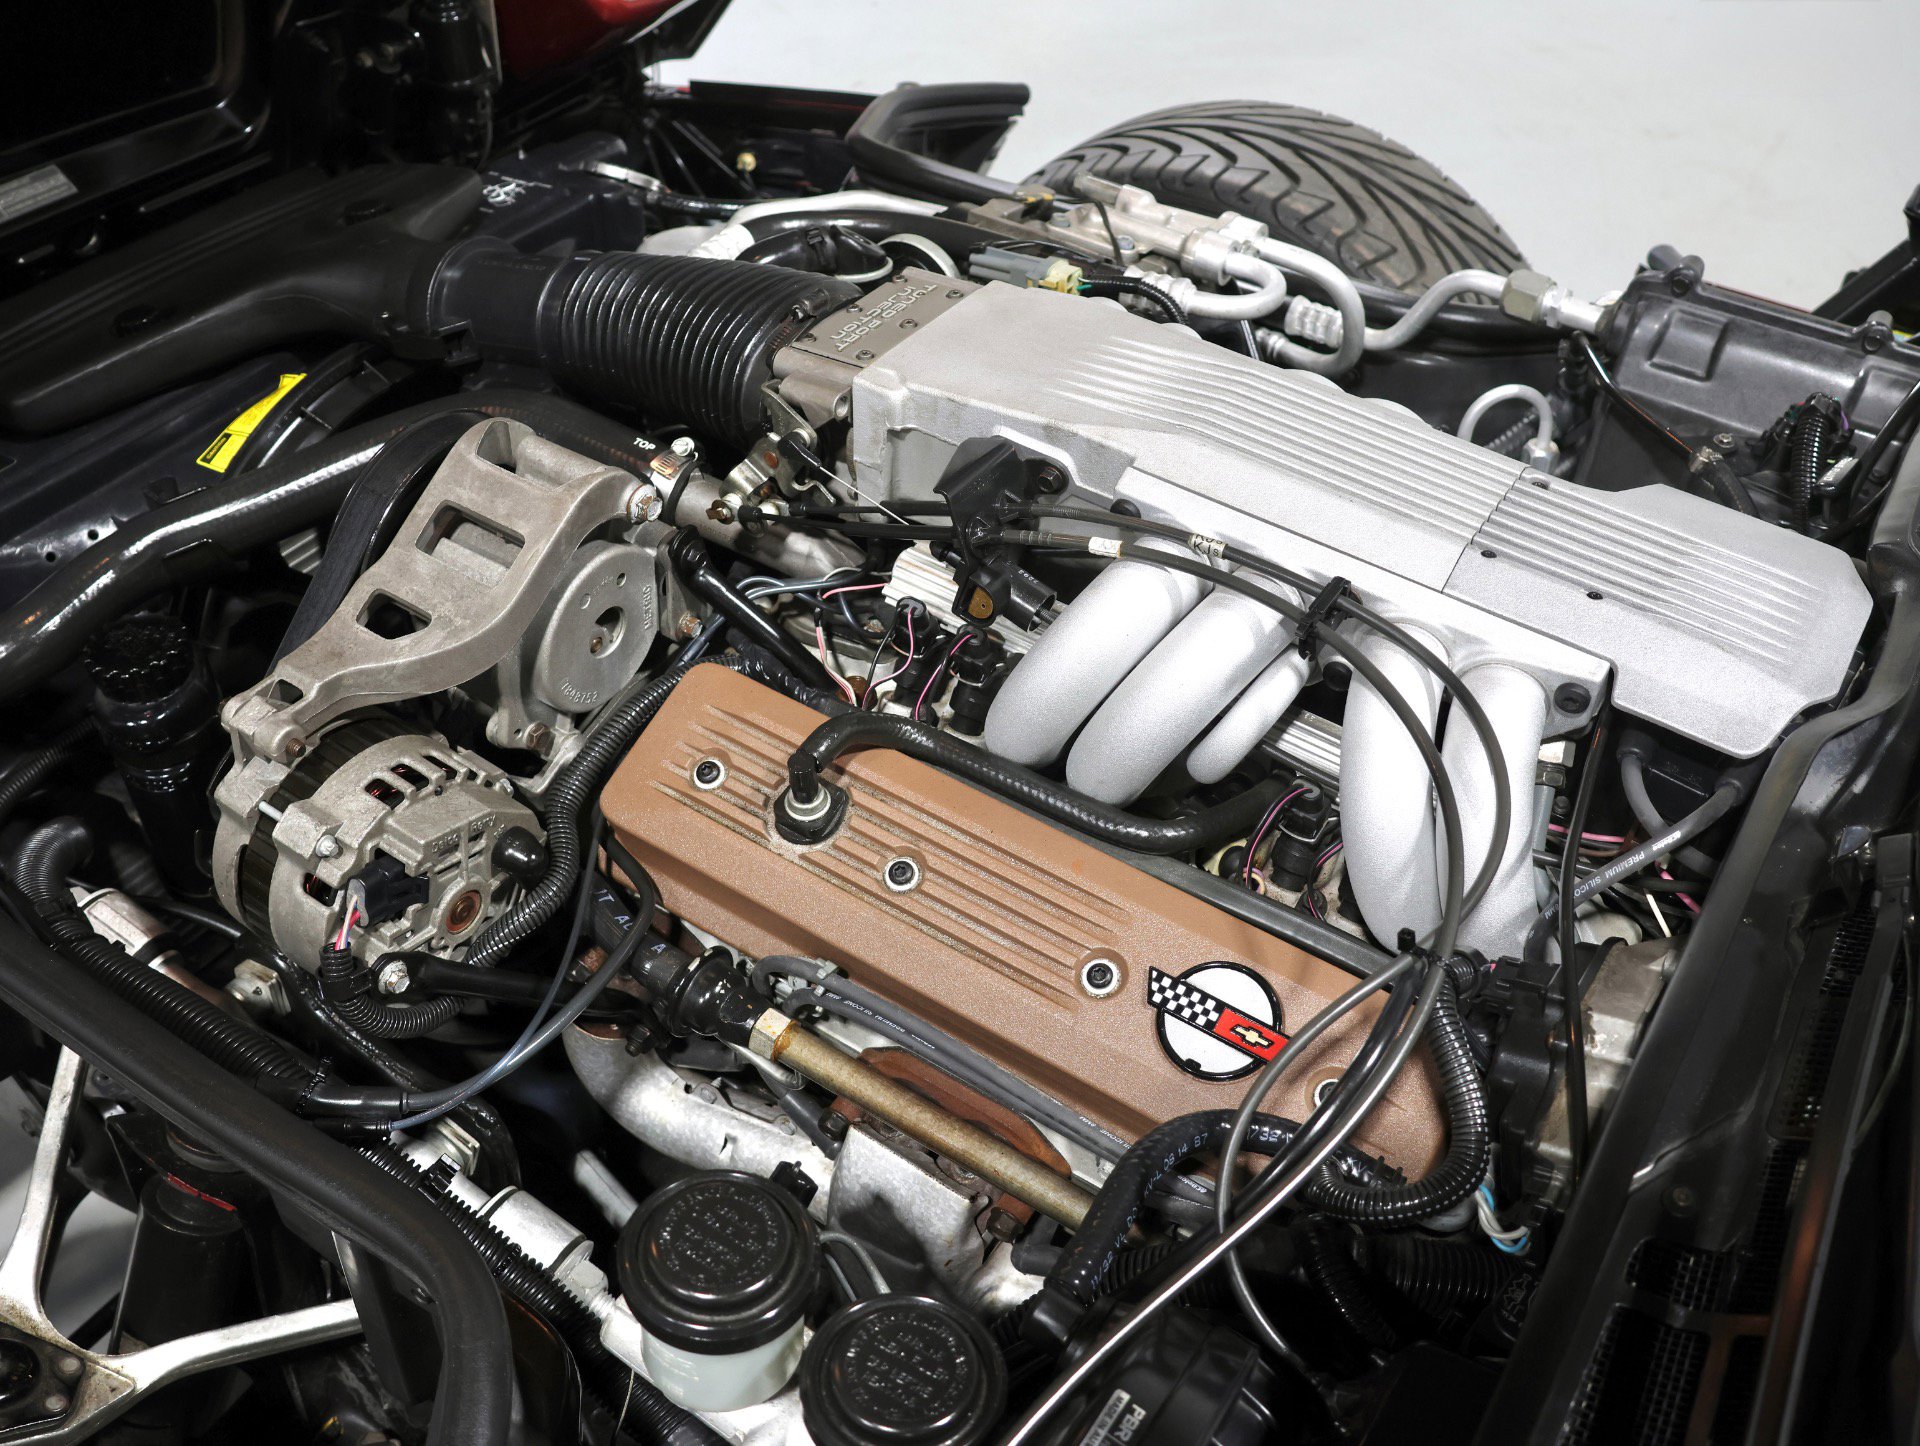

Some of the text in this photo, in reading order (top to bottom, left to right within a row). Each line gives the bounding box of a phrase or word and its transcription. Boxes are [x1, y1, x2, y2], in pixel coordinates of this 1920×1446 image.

[829, 285, 917, 340] INJECTION
[834, 283, 938, 352] TUNED PORT
[632, 437, 656, 451] TOP
[642, 584, 653, 631] METRIC
[431, 832, 460, 853] Delco
[470, 813, 496, 832] Remy
[1652, 829, 1682, 851] ACDelco
[1604, 850, 1646, 879] PREMIUM
[1574, 876, 1602, 898] SILICO
[1103, 1394, 1125, 1420] MADE
[1113, 1403, 1147, 1442] PBR
